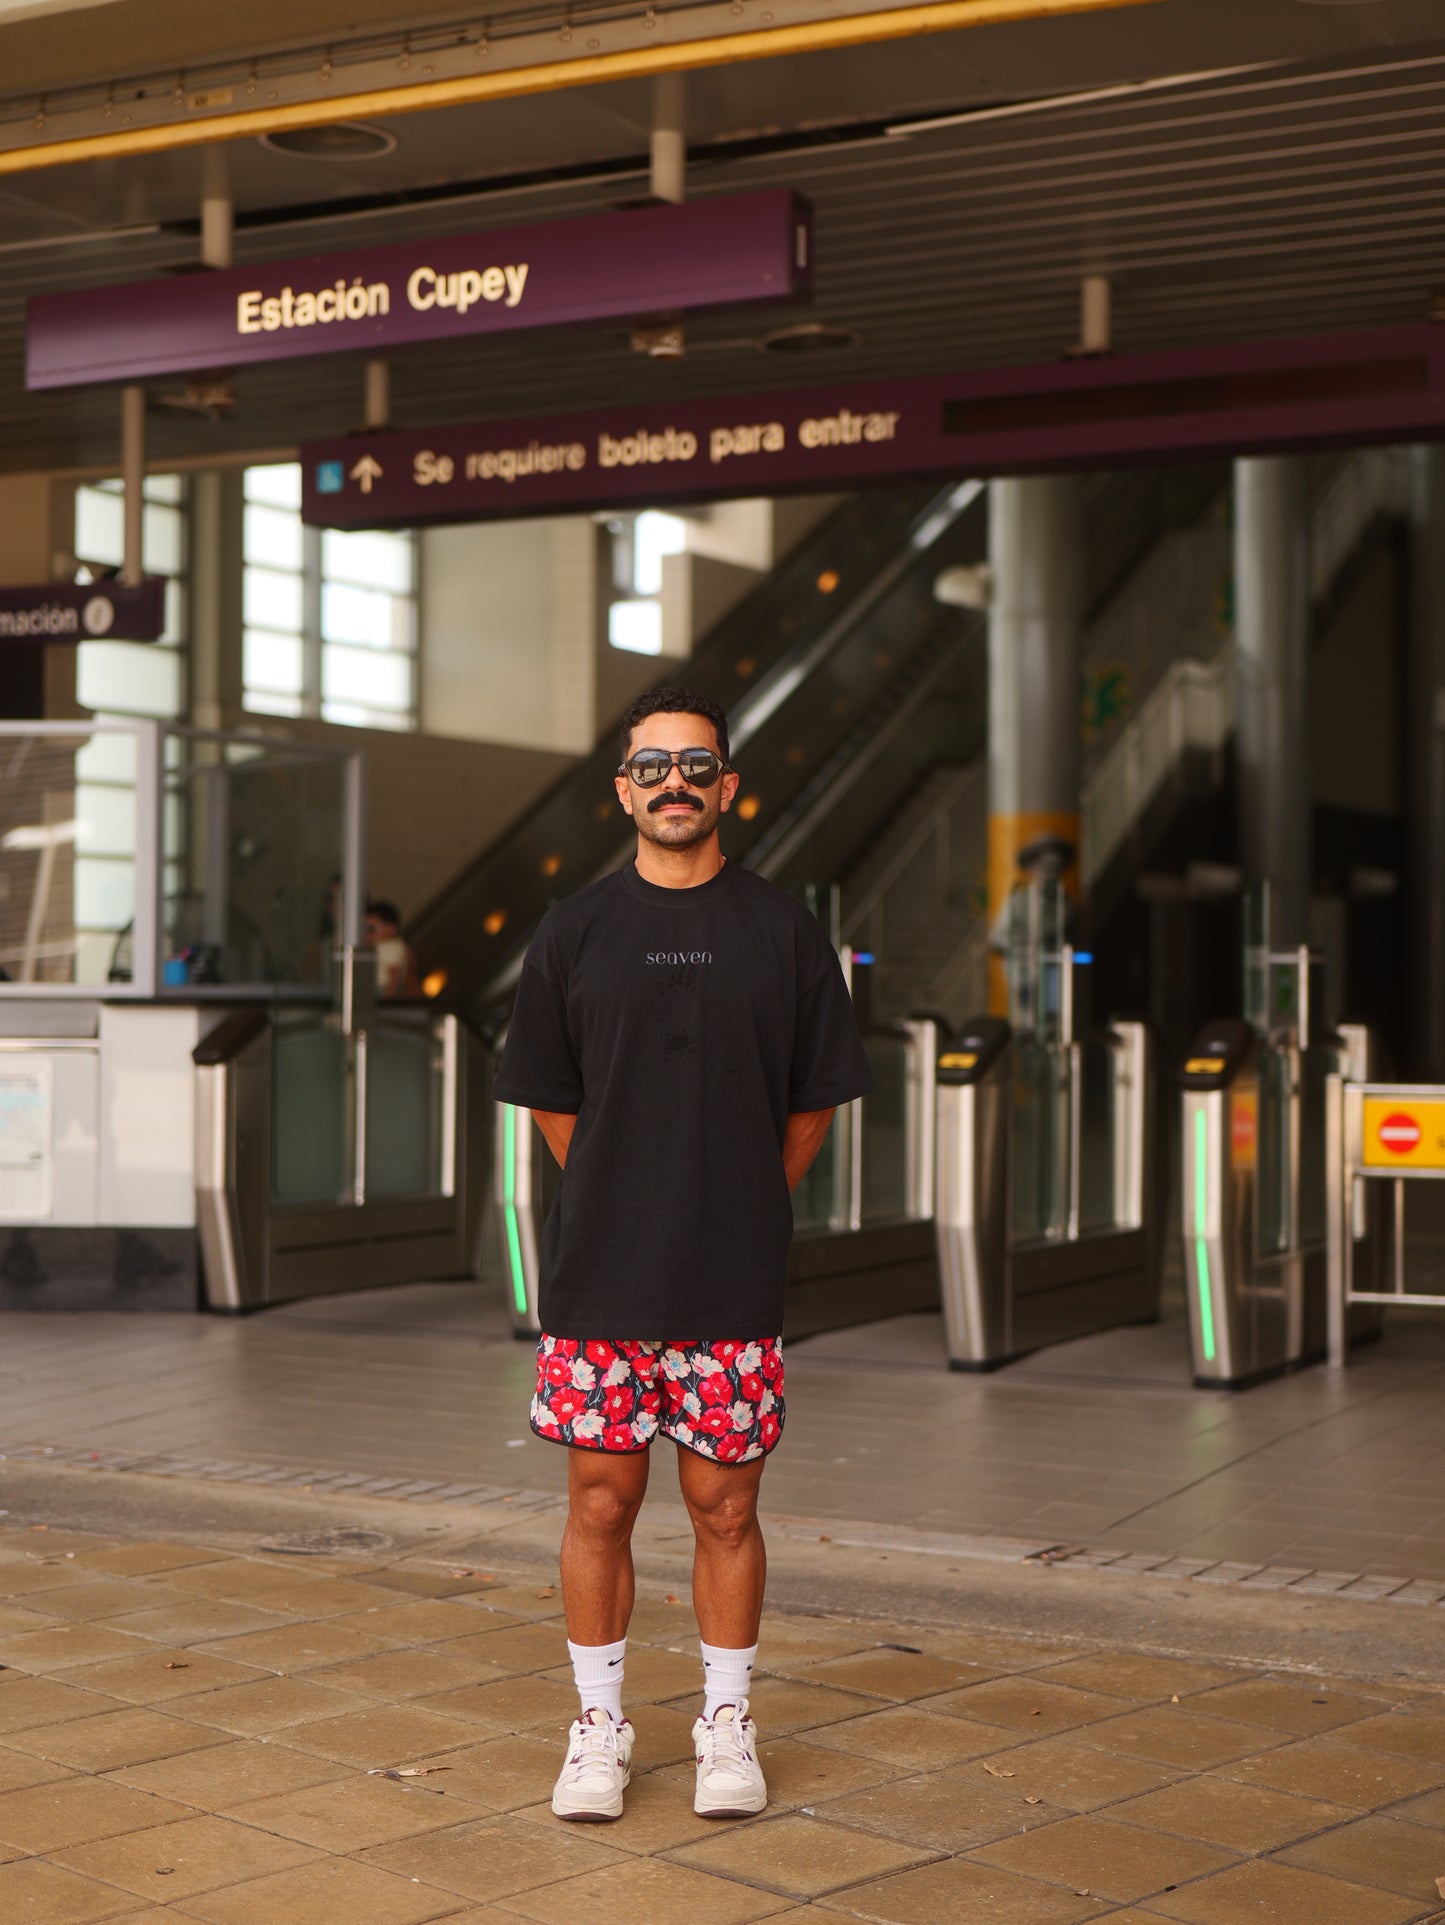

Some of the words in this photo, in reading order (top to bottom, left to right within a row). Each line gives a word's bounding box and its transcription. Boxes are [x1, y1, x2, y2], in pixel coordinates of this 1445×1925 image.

[237, 276, 390, 334] Estación
[407, 263, 529, 314] Cupey
[413, 450, 454, 486] Se
[466, 440, 586, 483] requiere
[598, 428, 698, 468] boleto
[710, 422, 785, 464] para
[798, 408, 899, 449] entrar
[646, 951, 713, 965] seaven
